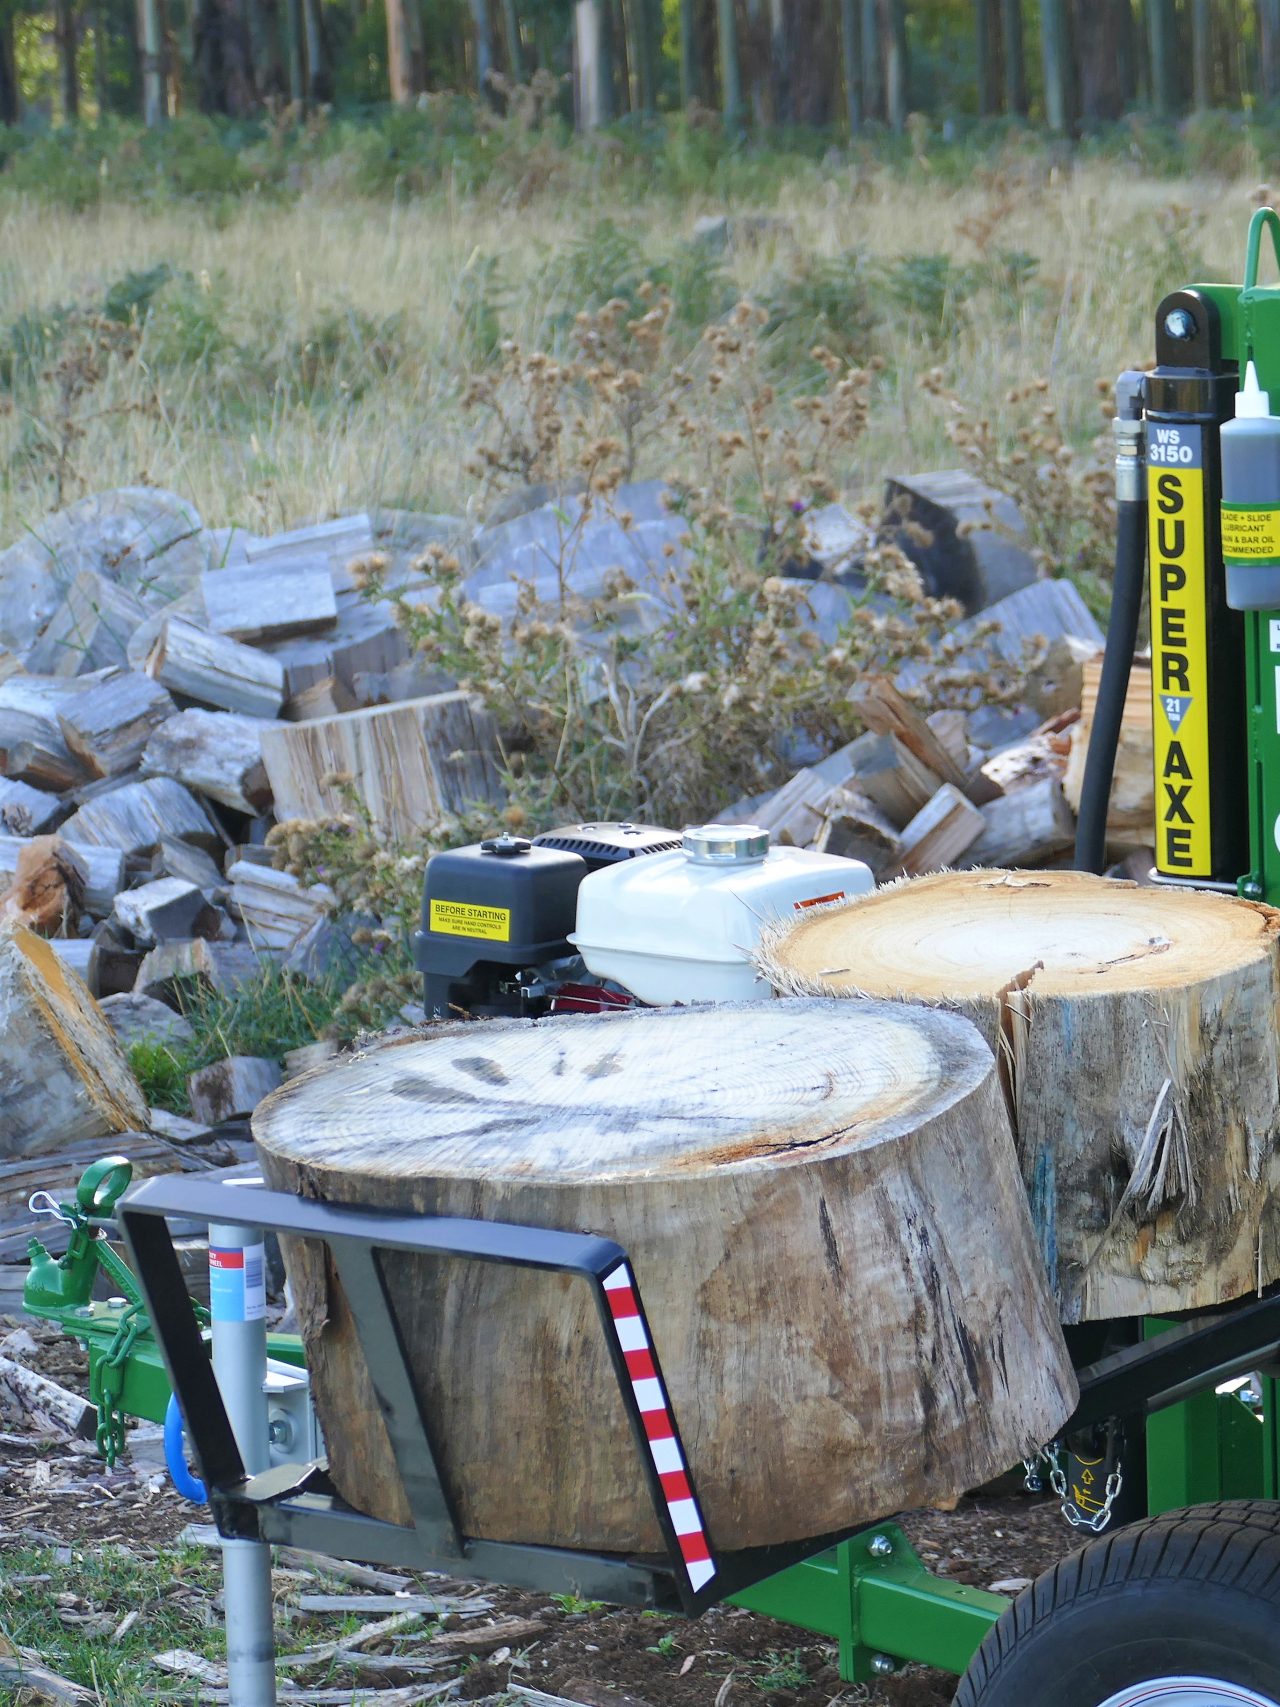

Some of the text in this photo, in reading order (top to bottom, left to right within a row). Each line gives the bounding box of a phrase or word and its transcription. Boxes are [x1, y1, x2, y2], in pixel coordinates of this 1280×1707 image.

[1156, 429, 1180, 444] WS
[1150, 445, 1193, 463] 3150
[1247, 514, 1272, 522] SLIDE
[1241, 536, 1259, 544] BAR
[1157, 474, 1191, 692] SUPER
[1166, 698, 1180, 712] 21
[1163, 741, 1195, 868] AXE
[435, 904, 506, 921] BEFORE STARTING
[477, 922, 502, 930] CONTROLS
